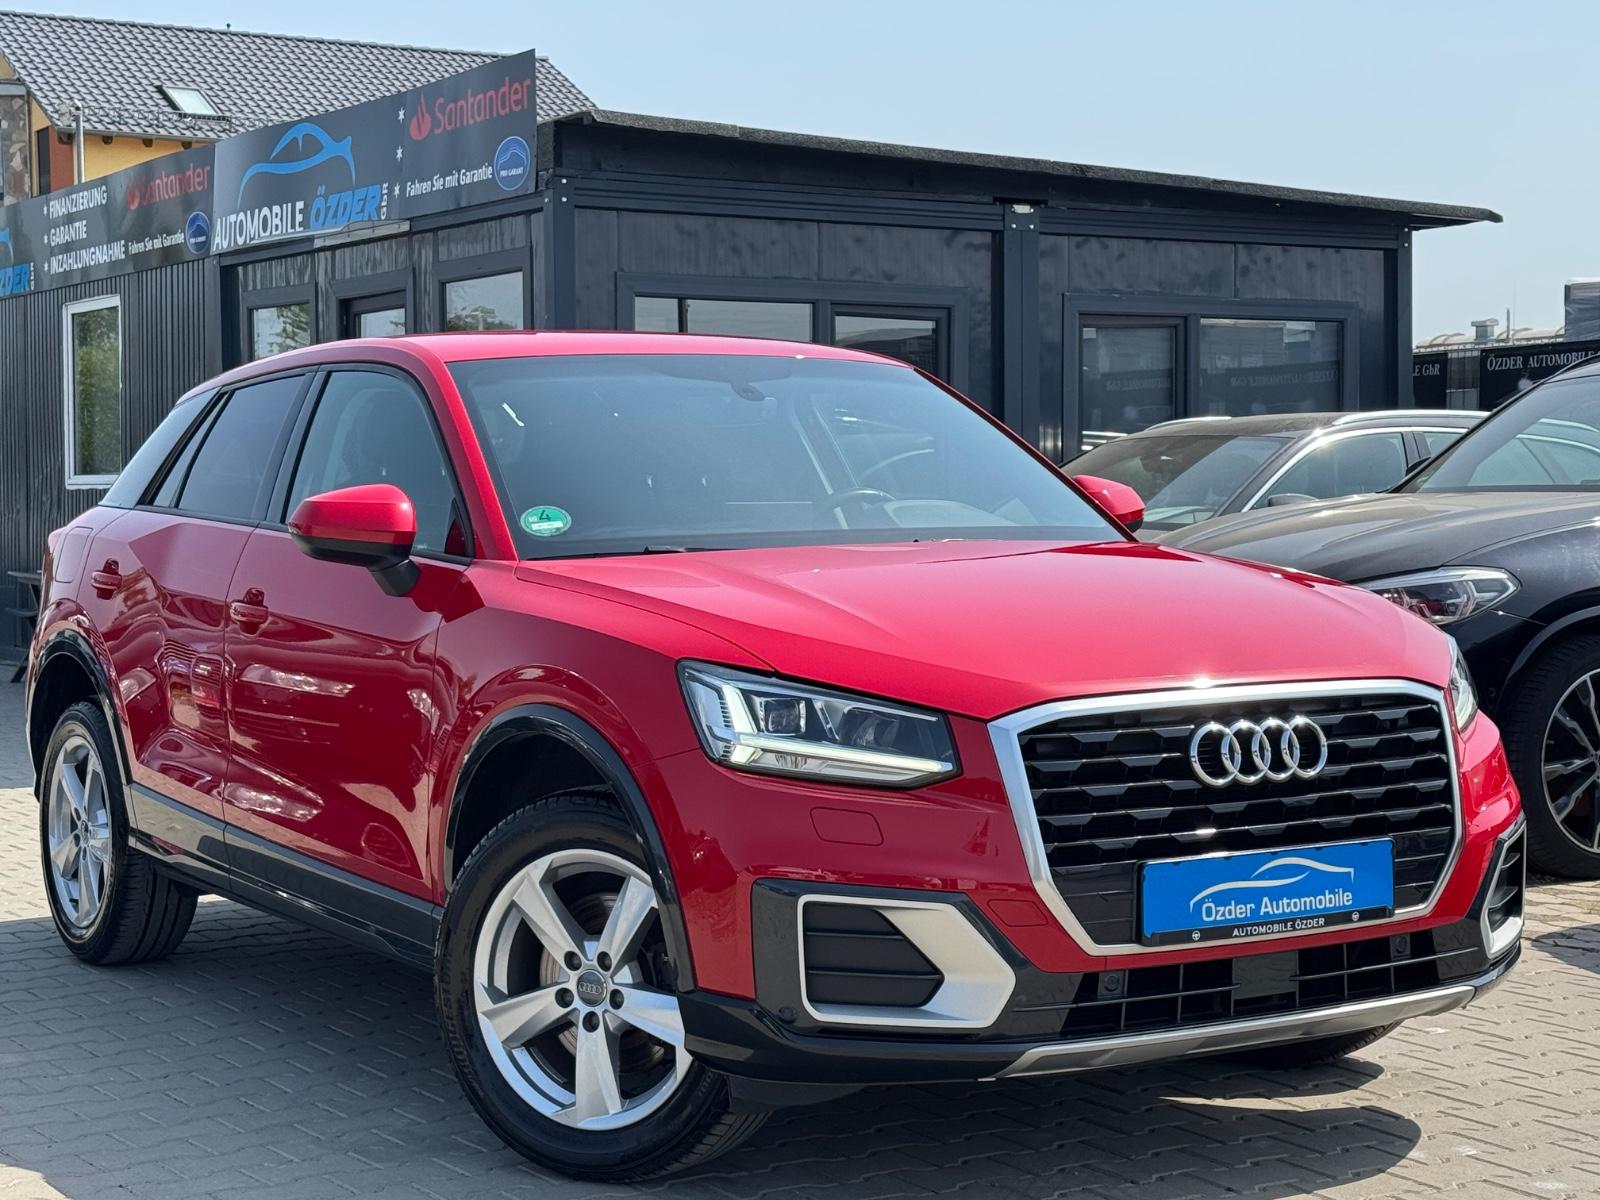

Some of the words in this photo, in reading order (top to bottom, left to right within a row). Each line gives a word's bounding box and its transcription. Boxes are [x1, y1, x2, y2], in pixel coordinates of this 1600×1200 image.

[433, 76, 531, 134] Santander
[141, 163, 211, 206] Santander
[406, 176, 431, 197] Fahren
[432, 173, 444, 191] Sie
[445, 169, 459, 188] mit
[460, 162, 493, 185] Garantie
[49, 185, 108, 220] FINANZIERUNG
[213, 200, 305, 251] AUTOMOBILE
[309, 183, 382, 231] ÖZDER
[49, 219, 87, 247] GARANTIE
[50, 239, 126, 275] INZAHLUNGNAHME
[1412, 364, 1421, 377] E
[1422, 363, 1440, 376] GbR
[1487, 353, 1523, 371] ÖZDER
[539, 509, 552, 521] 4
[1202, 898, 1256, 923] Özder
[1260, 888, 1353, 916] Automobile
[1232, 920, 1294, 938] AUTOMOBILE
[1294, 916, 1326, 931] ÖZDER
